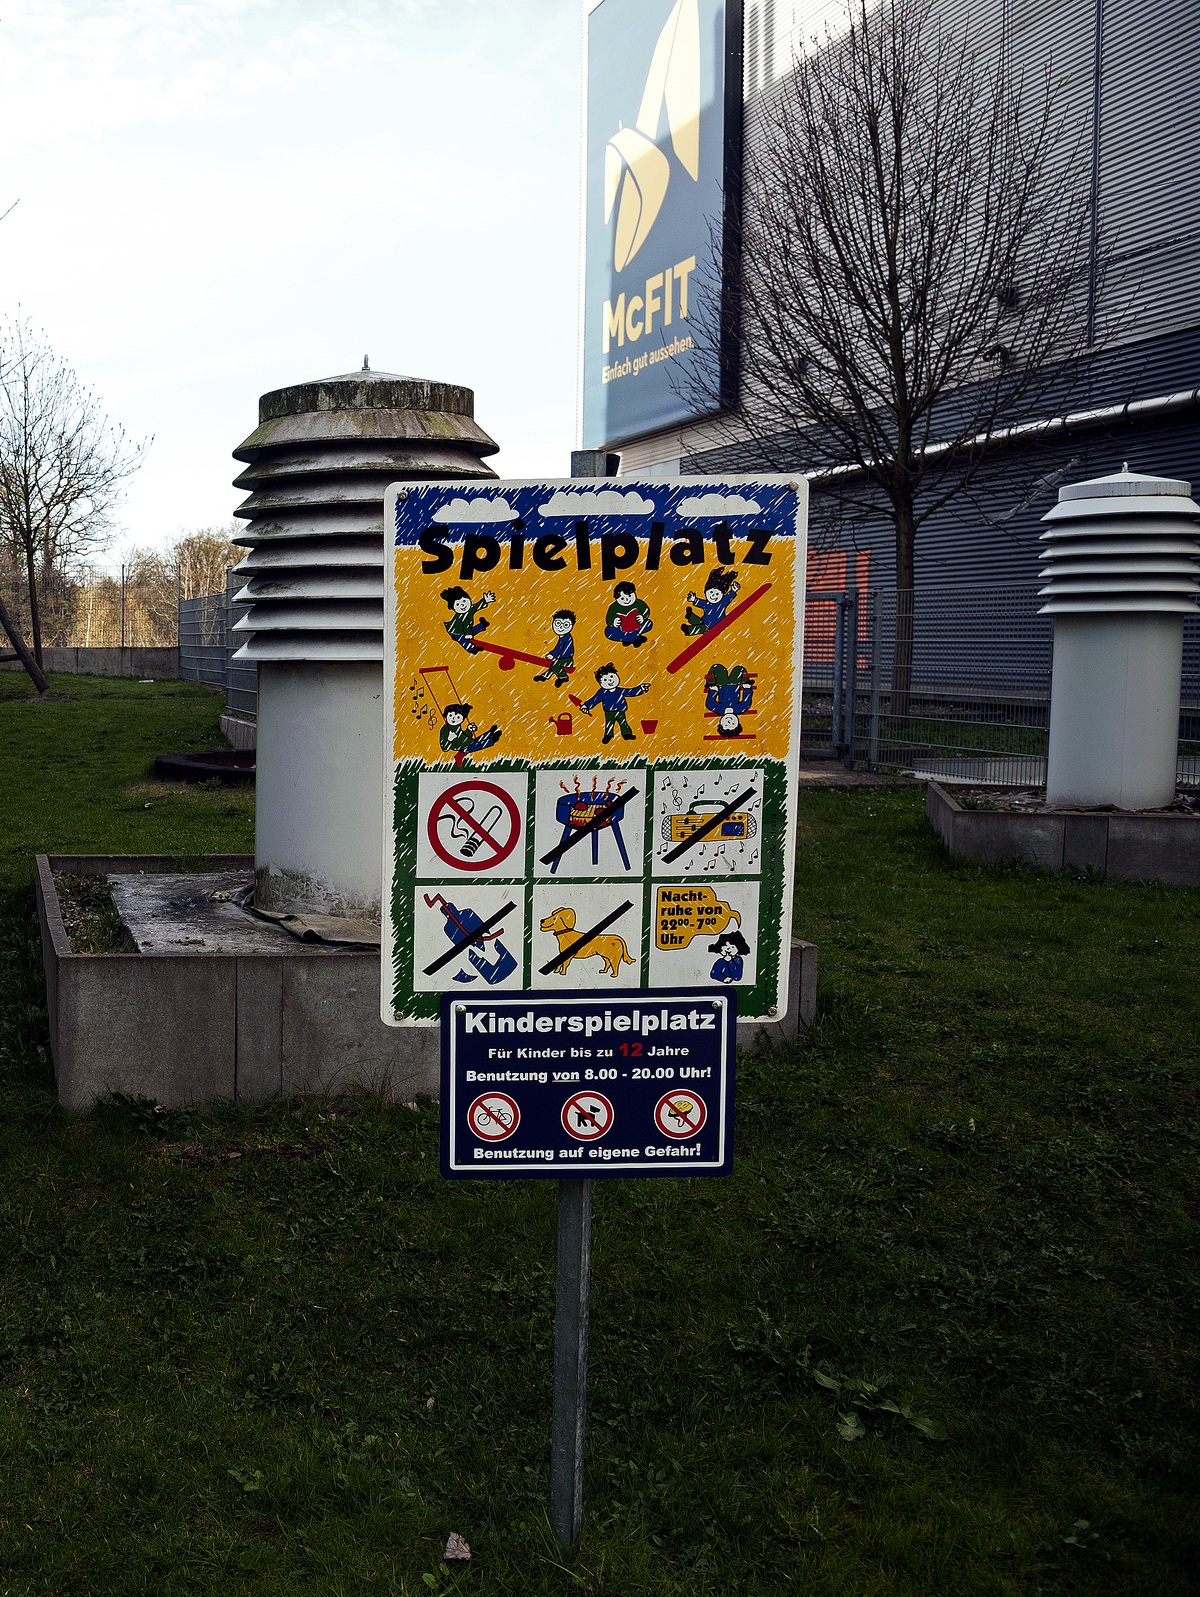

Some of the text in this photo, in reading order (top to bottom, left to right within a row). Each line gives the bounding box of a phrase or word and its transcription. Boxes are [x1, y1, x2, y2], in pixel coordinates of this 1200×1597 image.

[602, 255, 696, 355] McFIT
[602, 335, 695, 385] Einfach gut aussehen.
[418, 520, 775, 582] Spielplatz
[661, 890, 708, 902] Nacht-
[660, 904, 723, 916] ruhe von
[660, 933, 685, 945] Uhr
[465, 1009, 716, 1037] Kinderspielplatz
[488, 1042, 690, 1059] Für Kinder bis zu 12 Jahre
[466, 1070, 548, 1083] Benutzung
[552, 1071, 580, 1081] von
[584, 1068, 618, 1080] 8.00
[631, 1067, 675, 1079] 20.00
[679, 1066, 712, 1079] Uhr!
[473, 1143, 701, 1160] Benutzung auf eigene Gefahr!
